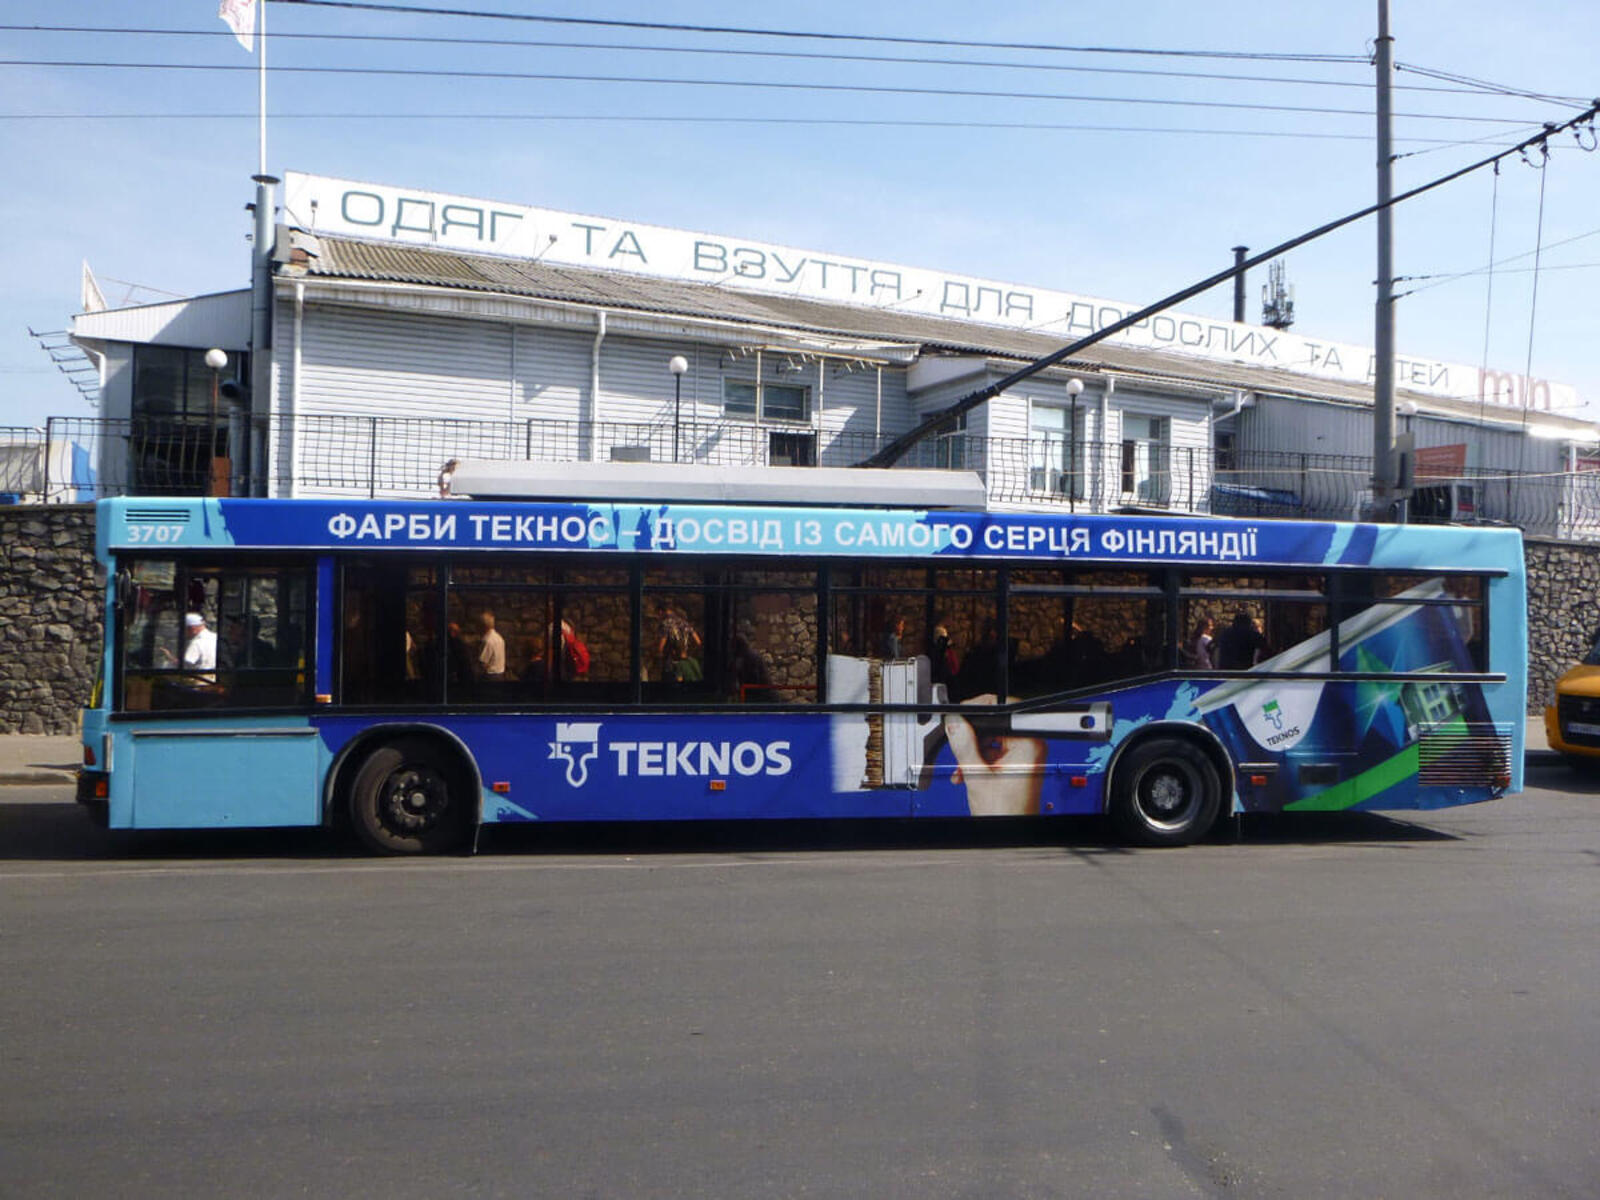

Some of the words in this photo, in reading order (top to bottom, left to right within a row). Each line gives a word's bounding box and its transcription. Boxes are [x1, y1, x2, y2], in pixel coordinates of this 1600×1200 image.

[341, 191, 523, 242] ОДЯГ
[572, 224, 647, 263] ТА
[693, 241, 900, 299] ВЗУТТЯ
[941, 282, 1033, 319] ДЛЯ
[1304, 342, 1343, 371] ТА
[1366, 354, 1449, 388] ТЕЙ
[126, 524, 184, 543] 3707
[327, 513, 455, 541] ФАРБИ
[470, 515, 611, 544] ТЕКНОС
[650, 520, 782, 549] ДОСВІД
[796, 522, 821, 546] ІЗ
[834, 523, 973, 550] САМОГО
[983, 525, 1091, 555] СЕРЦЯ
[1101, 528, 1257, 560] ФІНЛЯНДІЇ
[1266, 726, 1300, 746] TEKNOS
[609, 742, 792, 777] TEKNOS
